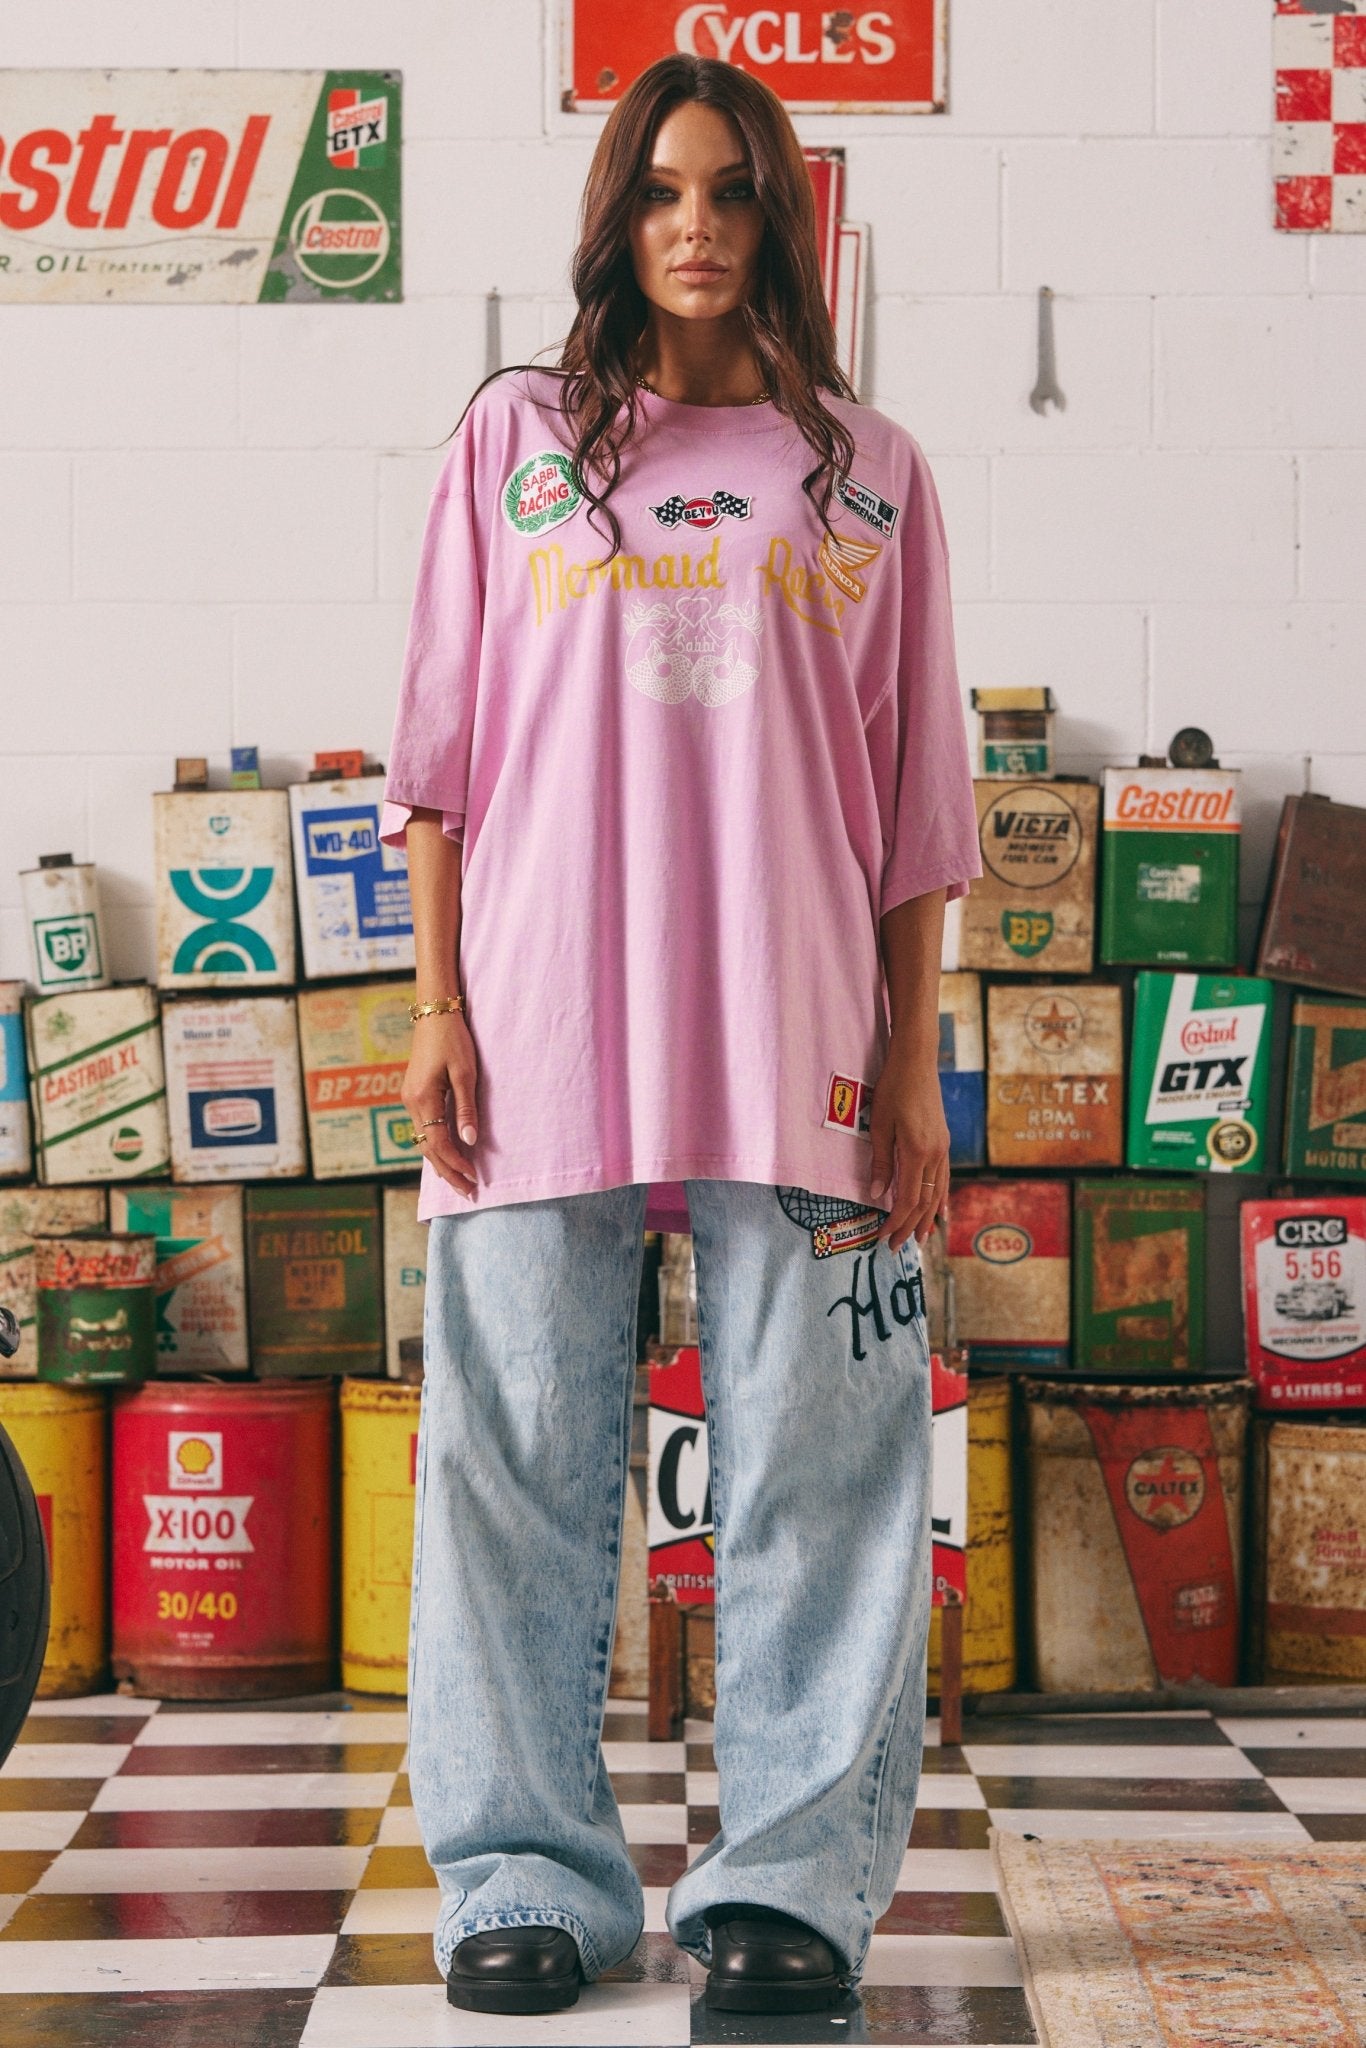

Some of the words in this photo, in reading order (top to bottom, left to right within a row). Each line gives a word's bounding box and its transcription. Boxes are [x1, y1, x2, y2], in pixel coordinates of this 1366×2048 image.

[674, 3, 896, 66] CYCLES
[333, 120, 381, 151] GTX
[0, 114, 272, 231] strol
[305, 225, 383, 249] Castrol
[36, 255, 88, 273] OIL
[522, 466, 558, 492] SABBI
[517, 483, 569, 518] RACING
[849, 500, 884, 532] BRENDA
[528, 535, 728, 628] Mermaid
[821, 548, 861, 596] BRENDA
[676, 632, 716, 653] Sabbi
[1115, 784, 1236, 821] Castrol
[993, 811, 1070, 838] VICTA
[313, 829, 373, 854] WD-40
[1002, 853, 1029, 865] FUEL
[1008, 917, 1050, 946] BP
[50, 933, 87, 963] BP
[1180, 1017, 1238, 1056] Castrol
[44, 1054, 115, 1104] CASTROL
[118, 1045, 140, 1071] XL
[316, 1077, 350, 1103] BP
[354, 1070, 405, 1098] ZOO
[1159, 1056, 1248, 1093] GTX
[997, 1081, 1109, 1105] CALTEX
[1028, 1109, 1075, 1126] RPM
[257, 1228, 368, 1259] ENERGOL
[834, 1219, 880, 1242] BEAUTIFUL
[1278, 1219, 1344, 1245] CRC
[1285, 1382, 1344, 1398] LITRES
[1133, 1481, 1199, 1496] CALTEX
[157, 1509, 236, 1540] X-100
[150, 1557, 210, 1571] MOTOR
[214, 1557, 243, 1570] OIL
[157, 1590, 238, 1620] 30/40
